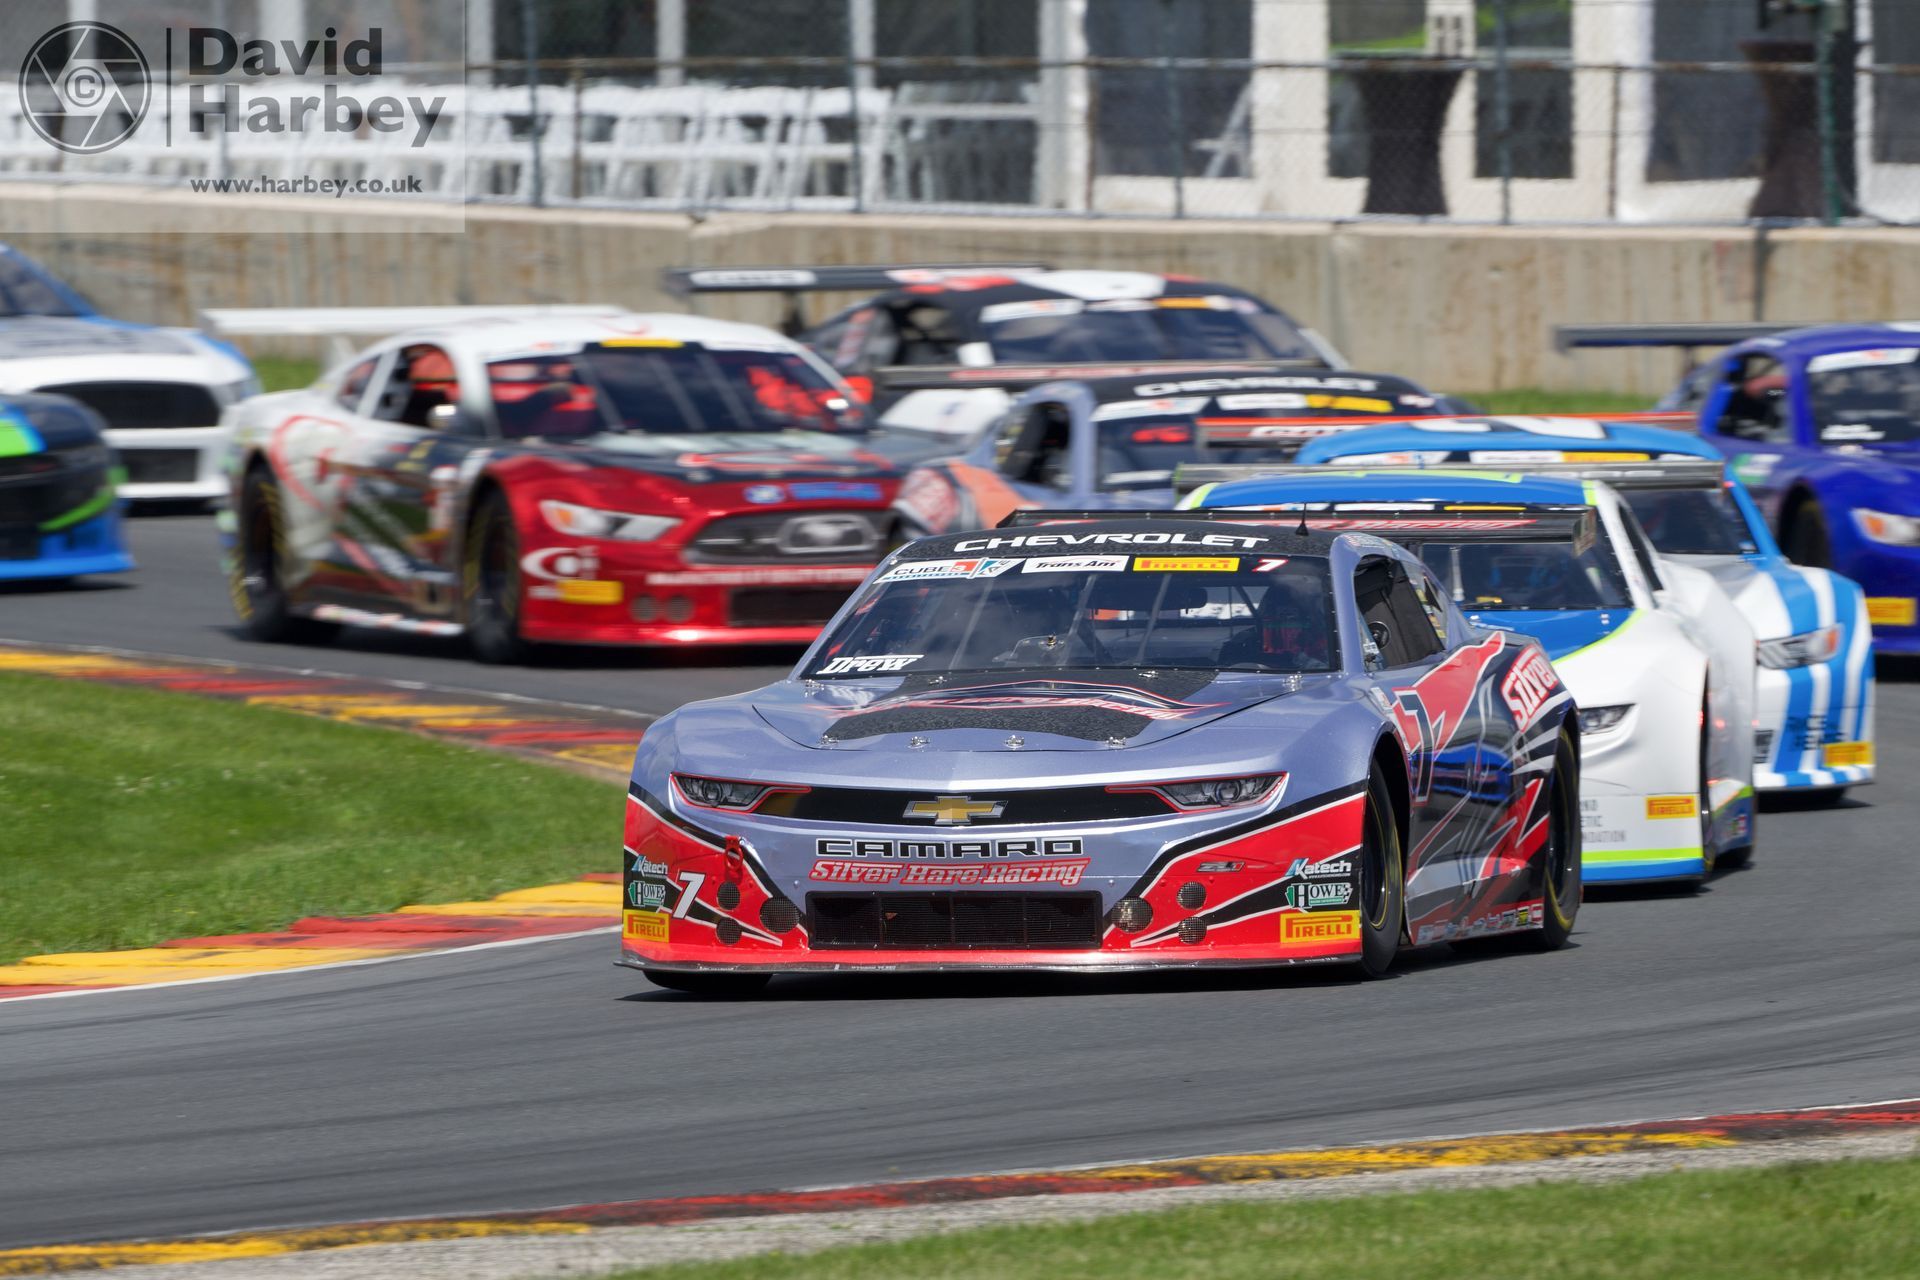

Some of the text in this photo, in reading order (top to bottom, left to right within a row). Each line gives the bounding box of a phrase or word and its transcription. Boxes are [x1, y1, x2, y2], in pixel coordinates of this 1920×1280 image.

[953, 533, 1269, 552] CHEVROLET
[1140, 559, 1233, 569] PIRELLI
[1251, 557, 1289, 572] 7
[815, 654, 925, 675] Drew
[1501, 644, 1560, 734] Silve
[816, 837, 1084, 858] CAMARO
[639, 855, 668, 877] Katech
[809, 858, 1091, 887] Silver Hare Racing
[1290, 858, 1352, 880] Katech
[634, 881, 664, 907] HOWE
[672, 870, 706, 920] 7
[1292, 883, 1345, 908] HOWE
[627, 914, 666, 938] PIRELLI
[1286, 914, 1353, 938] PIRELLI
